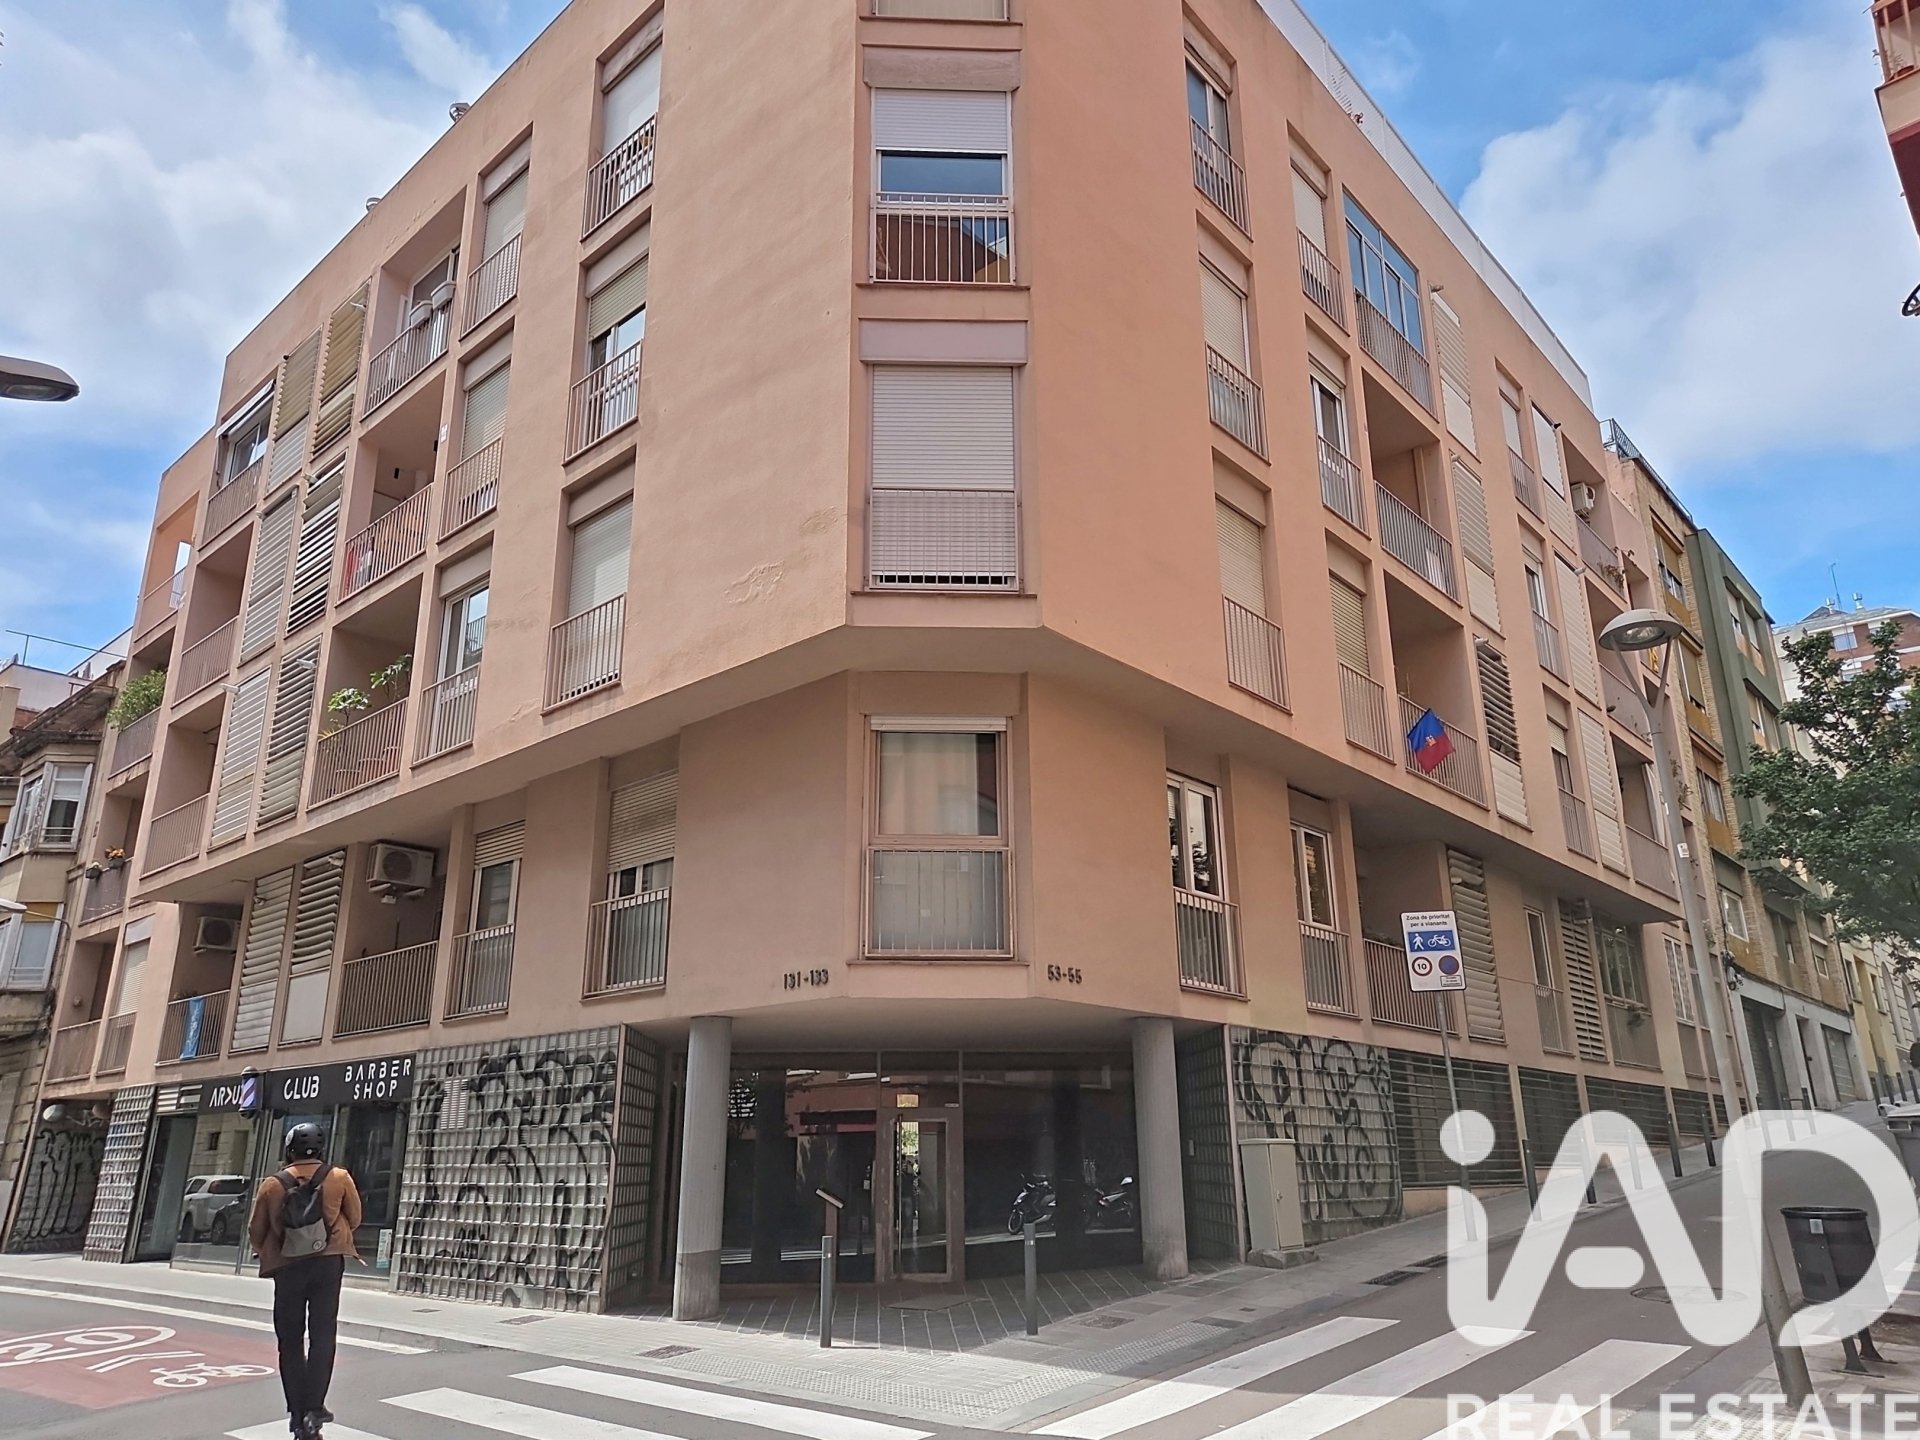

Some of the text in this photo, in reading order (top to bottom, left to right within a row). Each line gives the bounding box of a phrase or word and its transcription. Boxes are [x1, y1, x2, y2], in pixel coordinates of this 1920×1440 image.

[783, 968, 829, 990] 131-133
[1047, 964, 1083, 984] 53-55
[345, 1058, 412, 1083] BARBER
[283, 1075, 320, 1100] CLUB
[353, 1080, 399, 1101] SHOP
